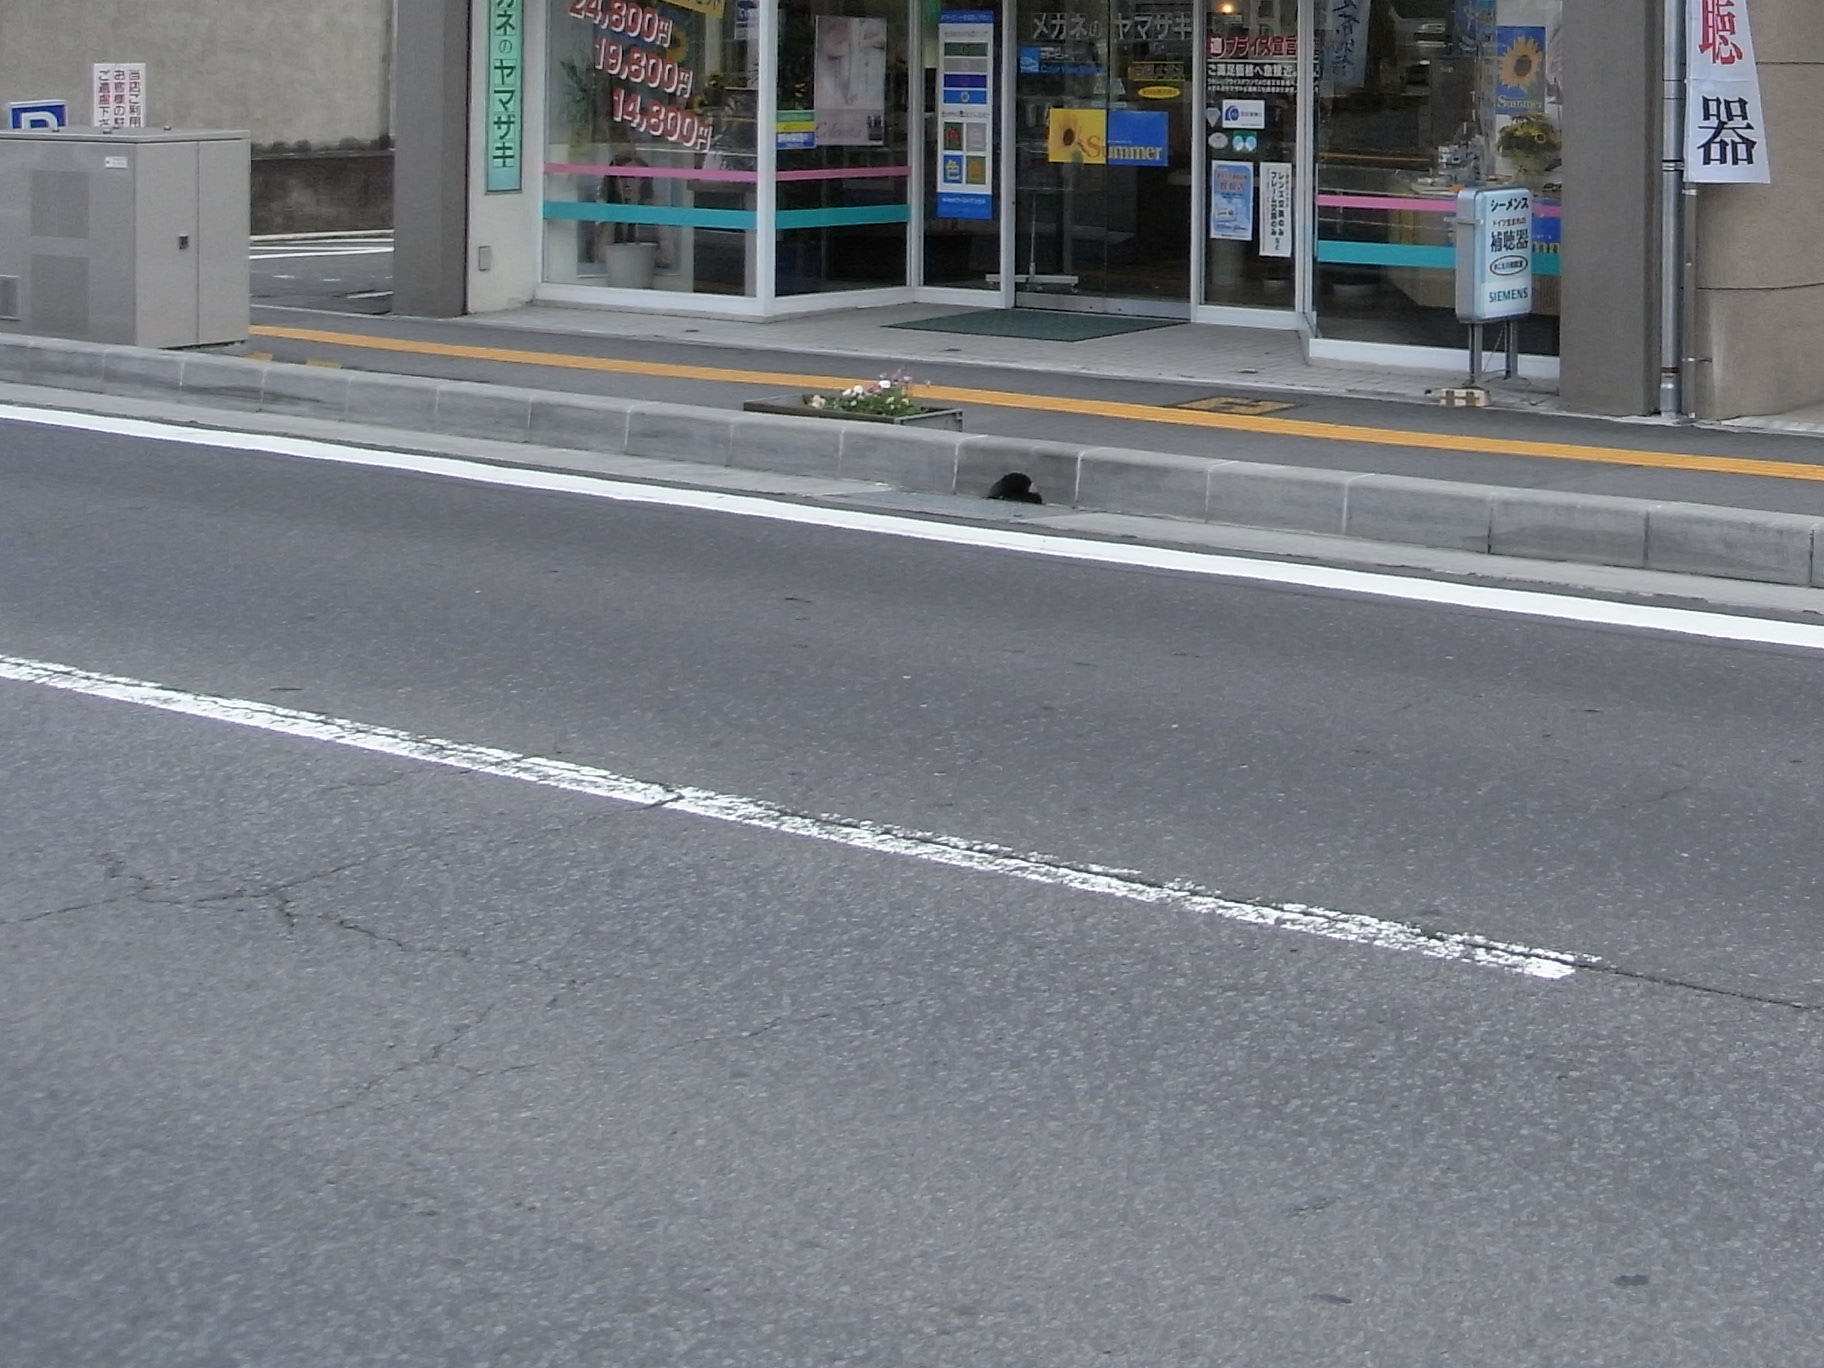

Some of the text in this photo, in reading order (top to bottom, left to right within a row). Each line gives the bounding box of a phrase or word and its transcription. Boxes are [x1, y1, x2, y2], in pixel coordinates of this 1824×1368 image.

[1114, 12, 1192, 41] ヤマザキ
[1086, 135, 1162, 160] Summer
[1490, 197, 1529, 212] シーメンス
[1490, 228, 1529, 252] 補聴器
[1488, 287, 1529, 303] SIEMENS
